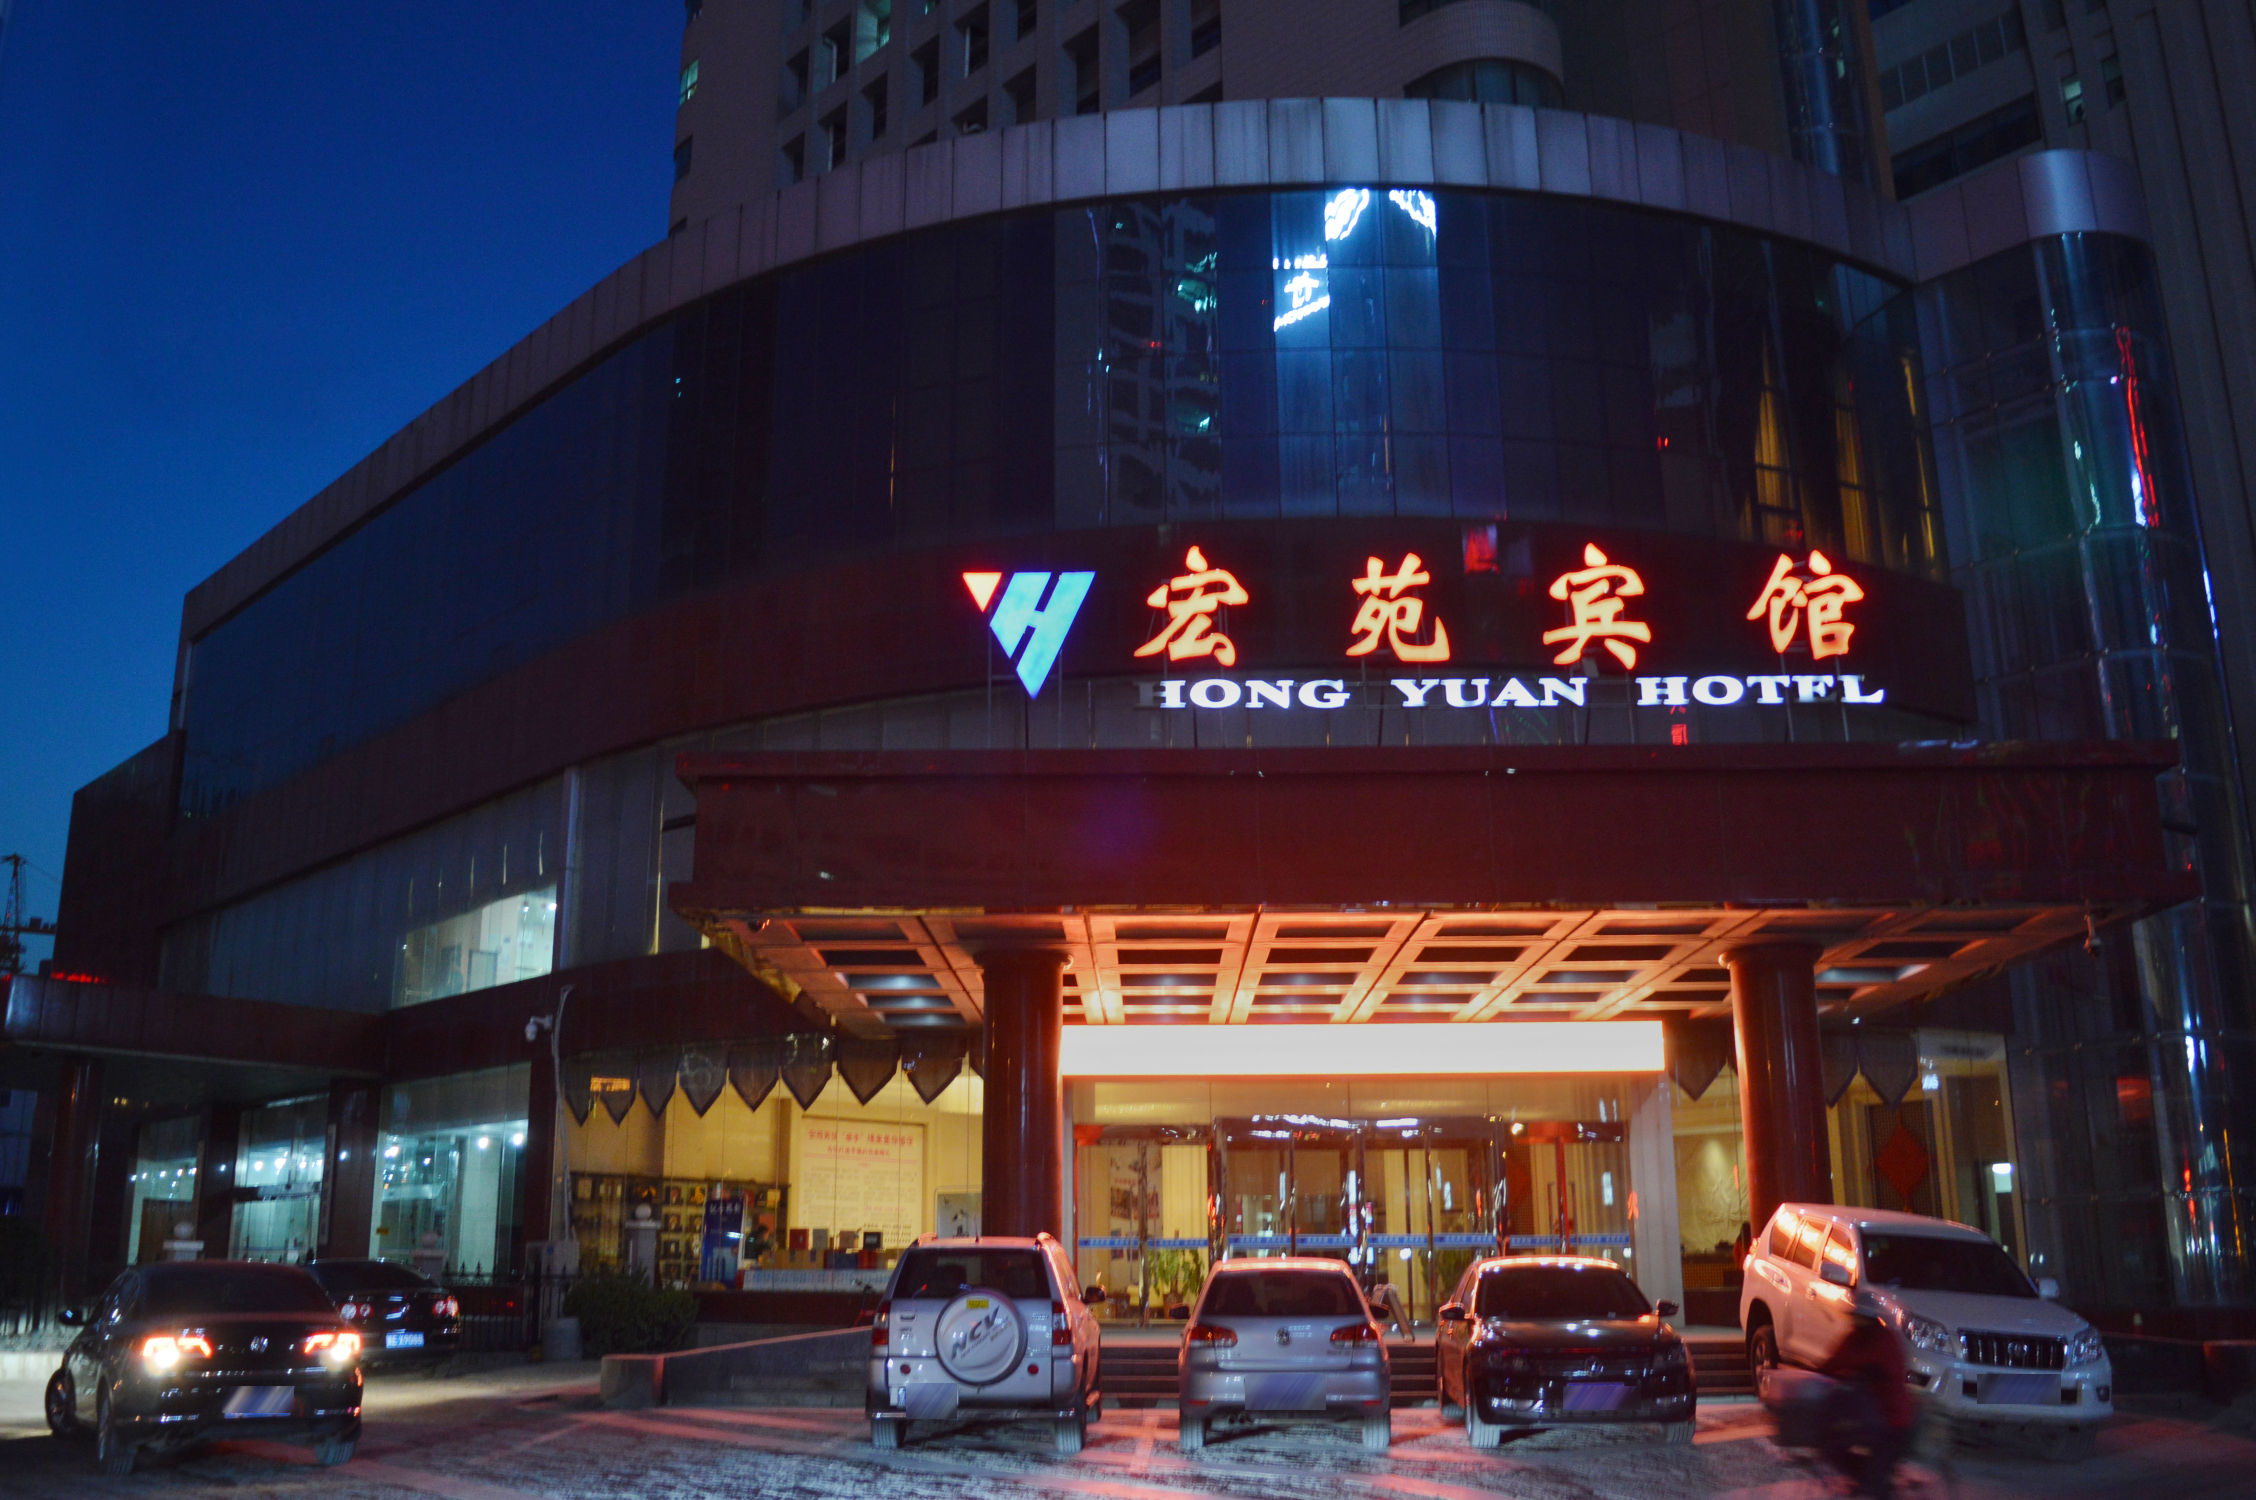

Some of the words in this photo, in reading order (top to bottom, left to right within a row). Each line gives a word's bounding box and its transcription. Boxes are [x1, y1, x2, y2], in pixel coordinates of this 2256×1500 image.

[1134, 543, 1865, 670] 宏苑宾馆
[1137, 678, 1351, 711] HONG
[1391, 676, 1588, 709] YUAN
[951, 1304, 1000, 1360] NCV
